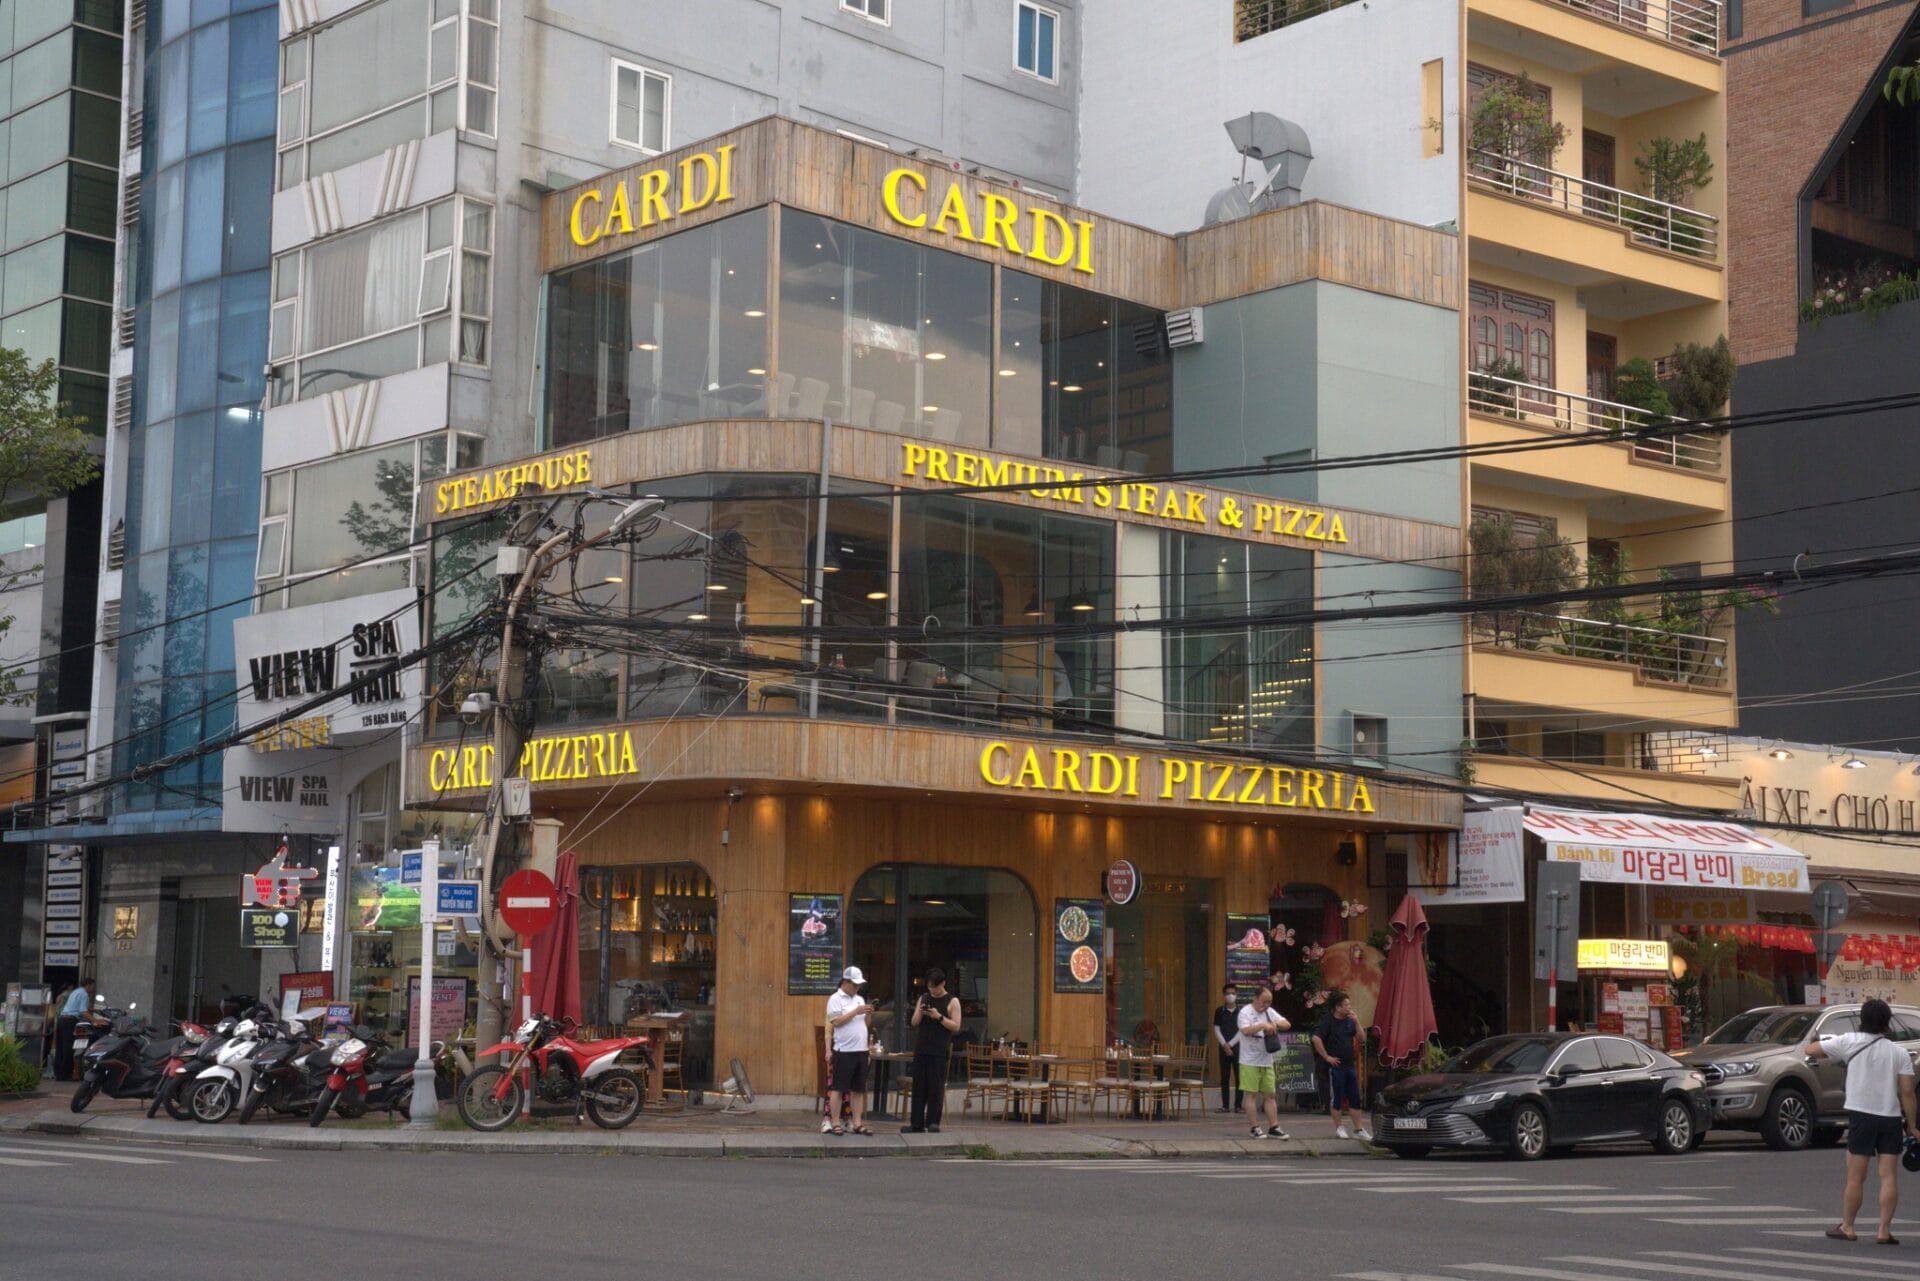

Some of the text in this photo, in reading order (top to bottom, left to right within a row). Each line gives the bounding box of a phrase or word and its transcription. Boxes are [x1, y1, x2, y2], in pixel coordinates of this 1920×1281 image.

[570, 144, 736, 247] CARDI
[883, 168, 1095, 275] CARDI
[435, 450, 592, 514] STEAKHOUSE
[902, 442, 1349, 543] PREMIUM STEAK & PIZZA
[352, 620, 400, 658] SPA
[249, 645, 339, 701] VIEW
[350, 666, 403, 705] NAIL
[519, 730, 639, 782] PIZZERIA
[240, 776, 295, 803] VIEW
[302, 775, 328, 789] SPA
[979, 742, 1376, 814] CARDI PIZZERIA
[300, 792, 329, 807] NAIL
[1774, 786, 1811, 826] XE
[1522, 808, 1674, 843] 마담리
[1653, 820, 1774, 849] 반미
[1622, 849, 1687, 883] 마담리
[1694, 852, 1735, 885] 반미
[1742, 865, 1799, 888] Bread
[252, 915, 273, 925] 100
[253, 926, 286, 938] Shop
[1610, 942, 1642, 958] 마담리
[1645, 943, 1666, 960] 반미
